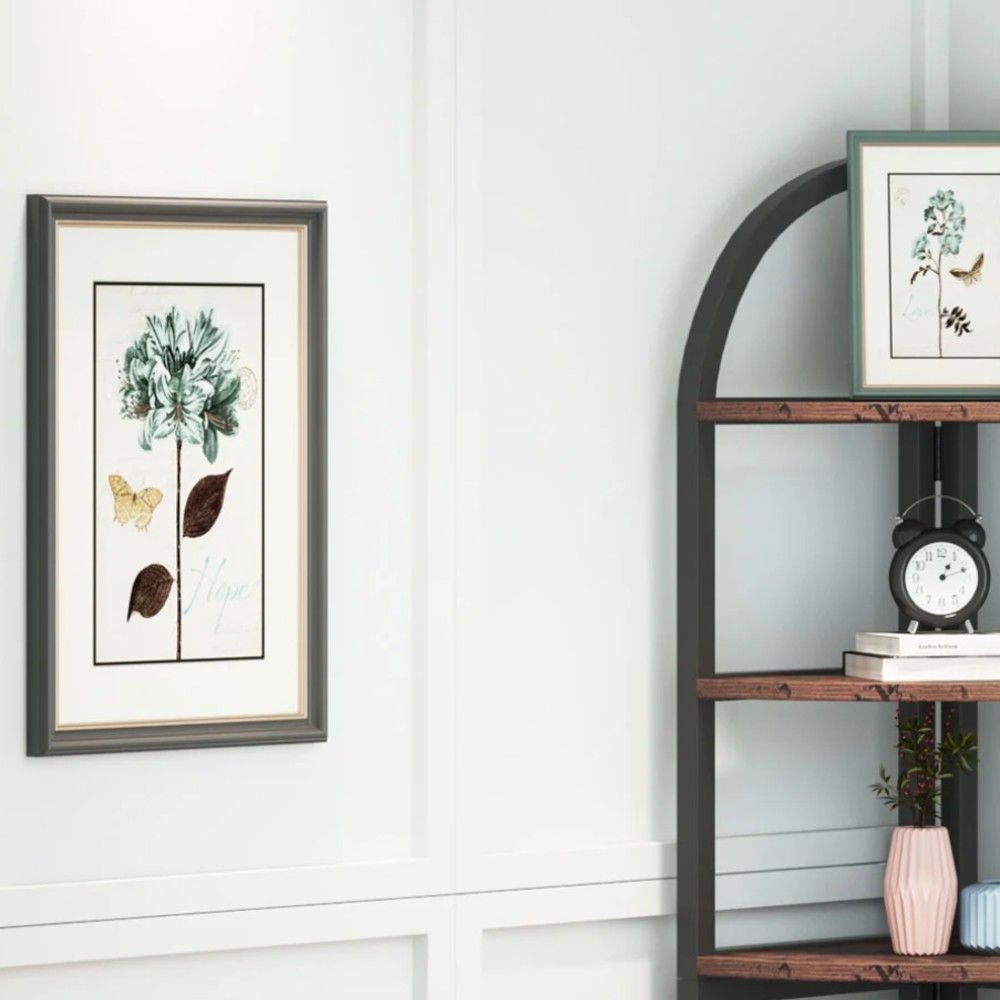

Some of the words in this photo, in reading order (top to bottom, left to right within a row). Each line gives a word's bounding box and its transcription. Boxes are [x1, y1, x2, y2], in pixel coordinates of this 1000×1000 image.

[925, 550, 933, 562] 11
[936, 547, 948, 559] 12
[952, 550, 957, 562] 1
[915, 560, 926, 571] 10
[183, 556, 250, 634] Hope
